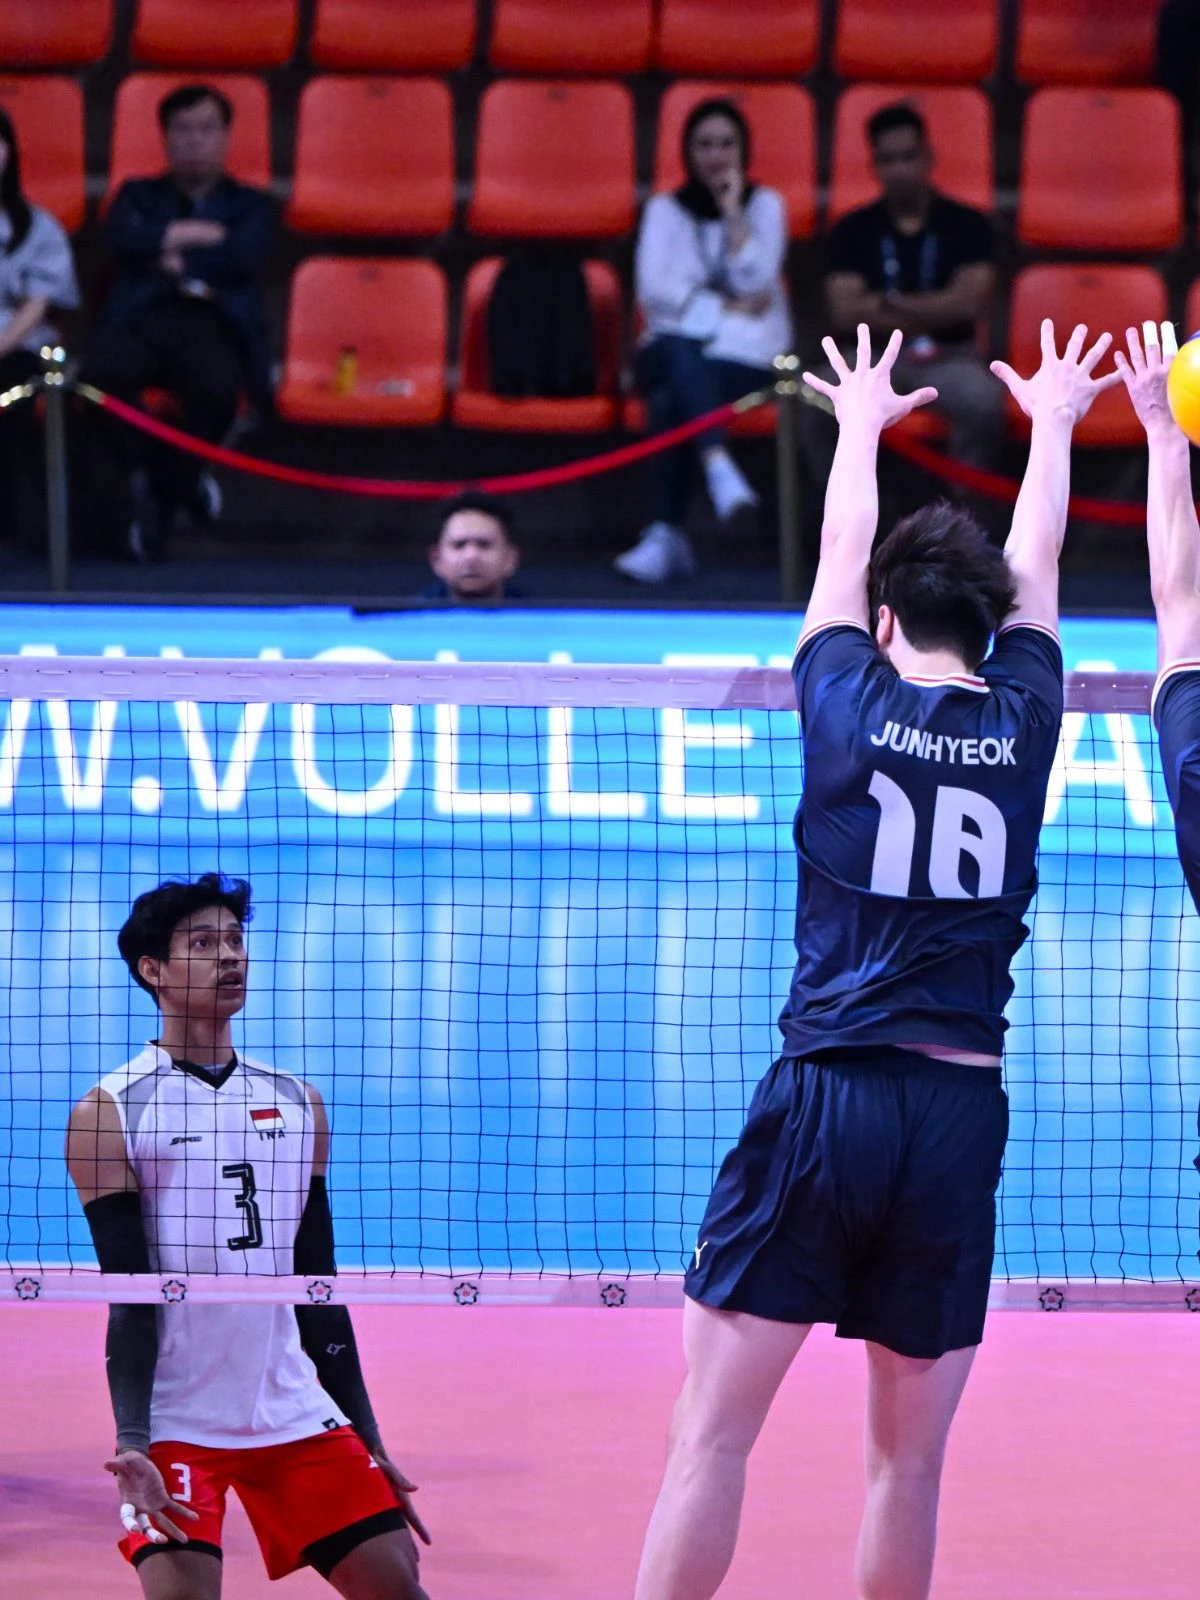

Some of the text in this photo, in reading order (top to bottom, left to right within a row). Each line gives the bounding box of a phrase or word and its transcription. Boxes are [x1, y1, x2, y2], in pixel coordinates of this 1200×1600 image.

[0, 643, 795, 820] W.VOLLE
[870, 721, 1016, 765] JUNHYEOK
[259, 1129, 286, 1141] INA
[222, 1163, 263, 1251] 3
[170, 1463, 191, 1502] 3
